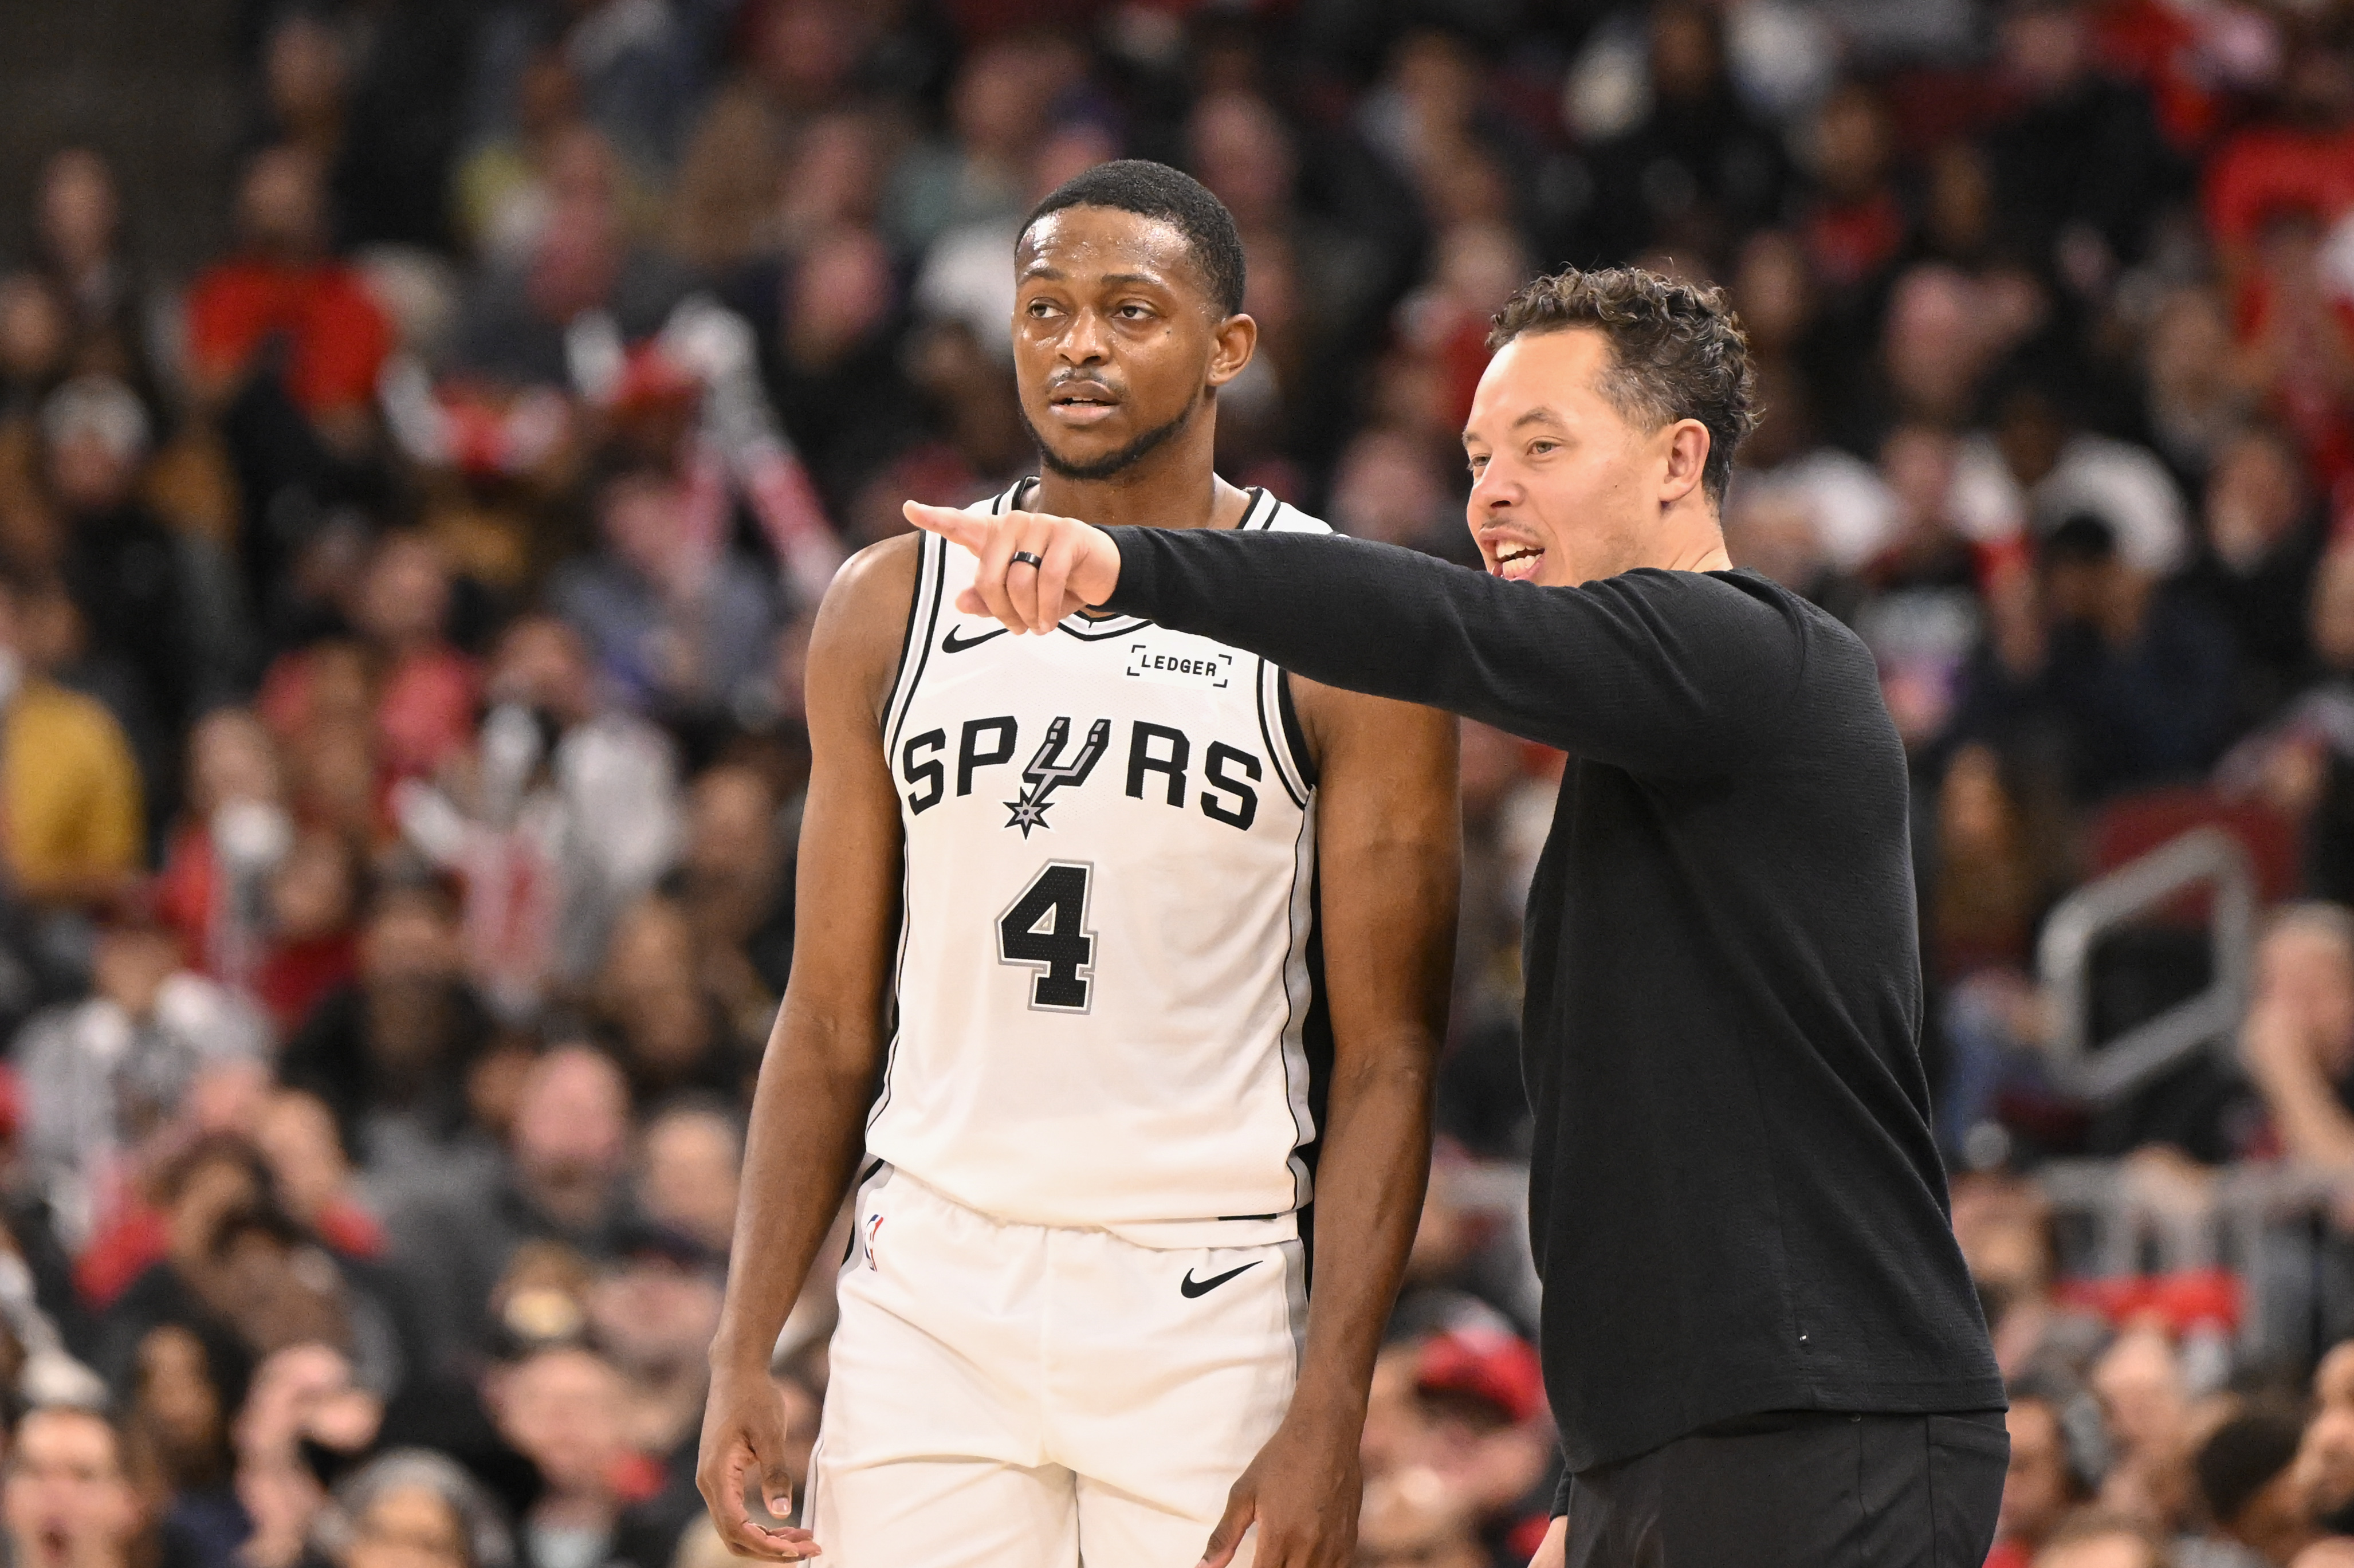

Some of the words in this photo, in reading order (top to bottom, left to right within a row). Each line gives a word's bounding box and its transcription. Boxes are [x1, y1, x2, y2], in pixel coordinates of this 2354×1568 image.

[1141, 654, 1217, 677] LEDGER
[902, 715, 1263, 840] SPURS
[993, 858, 1099, 1015] 4
